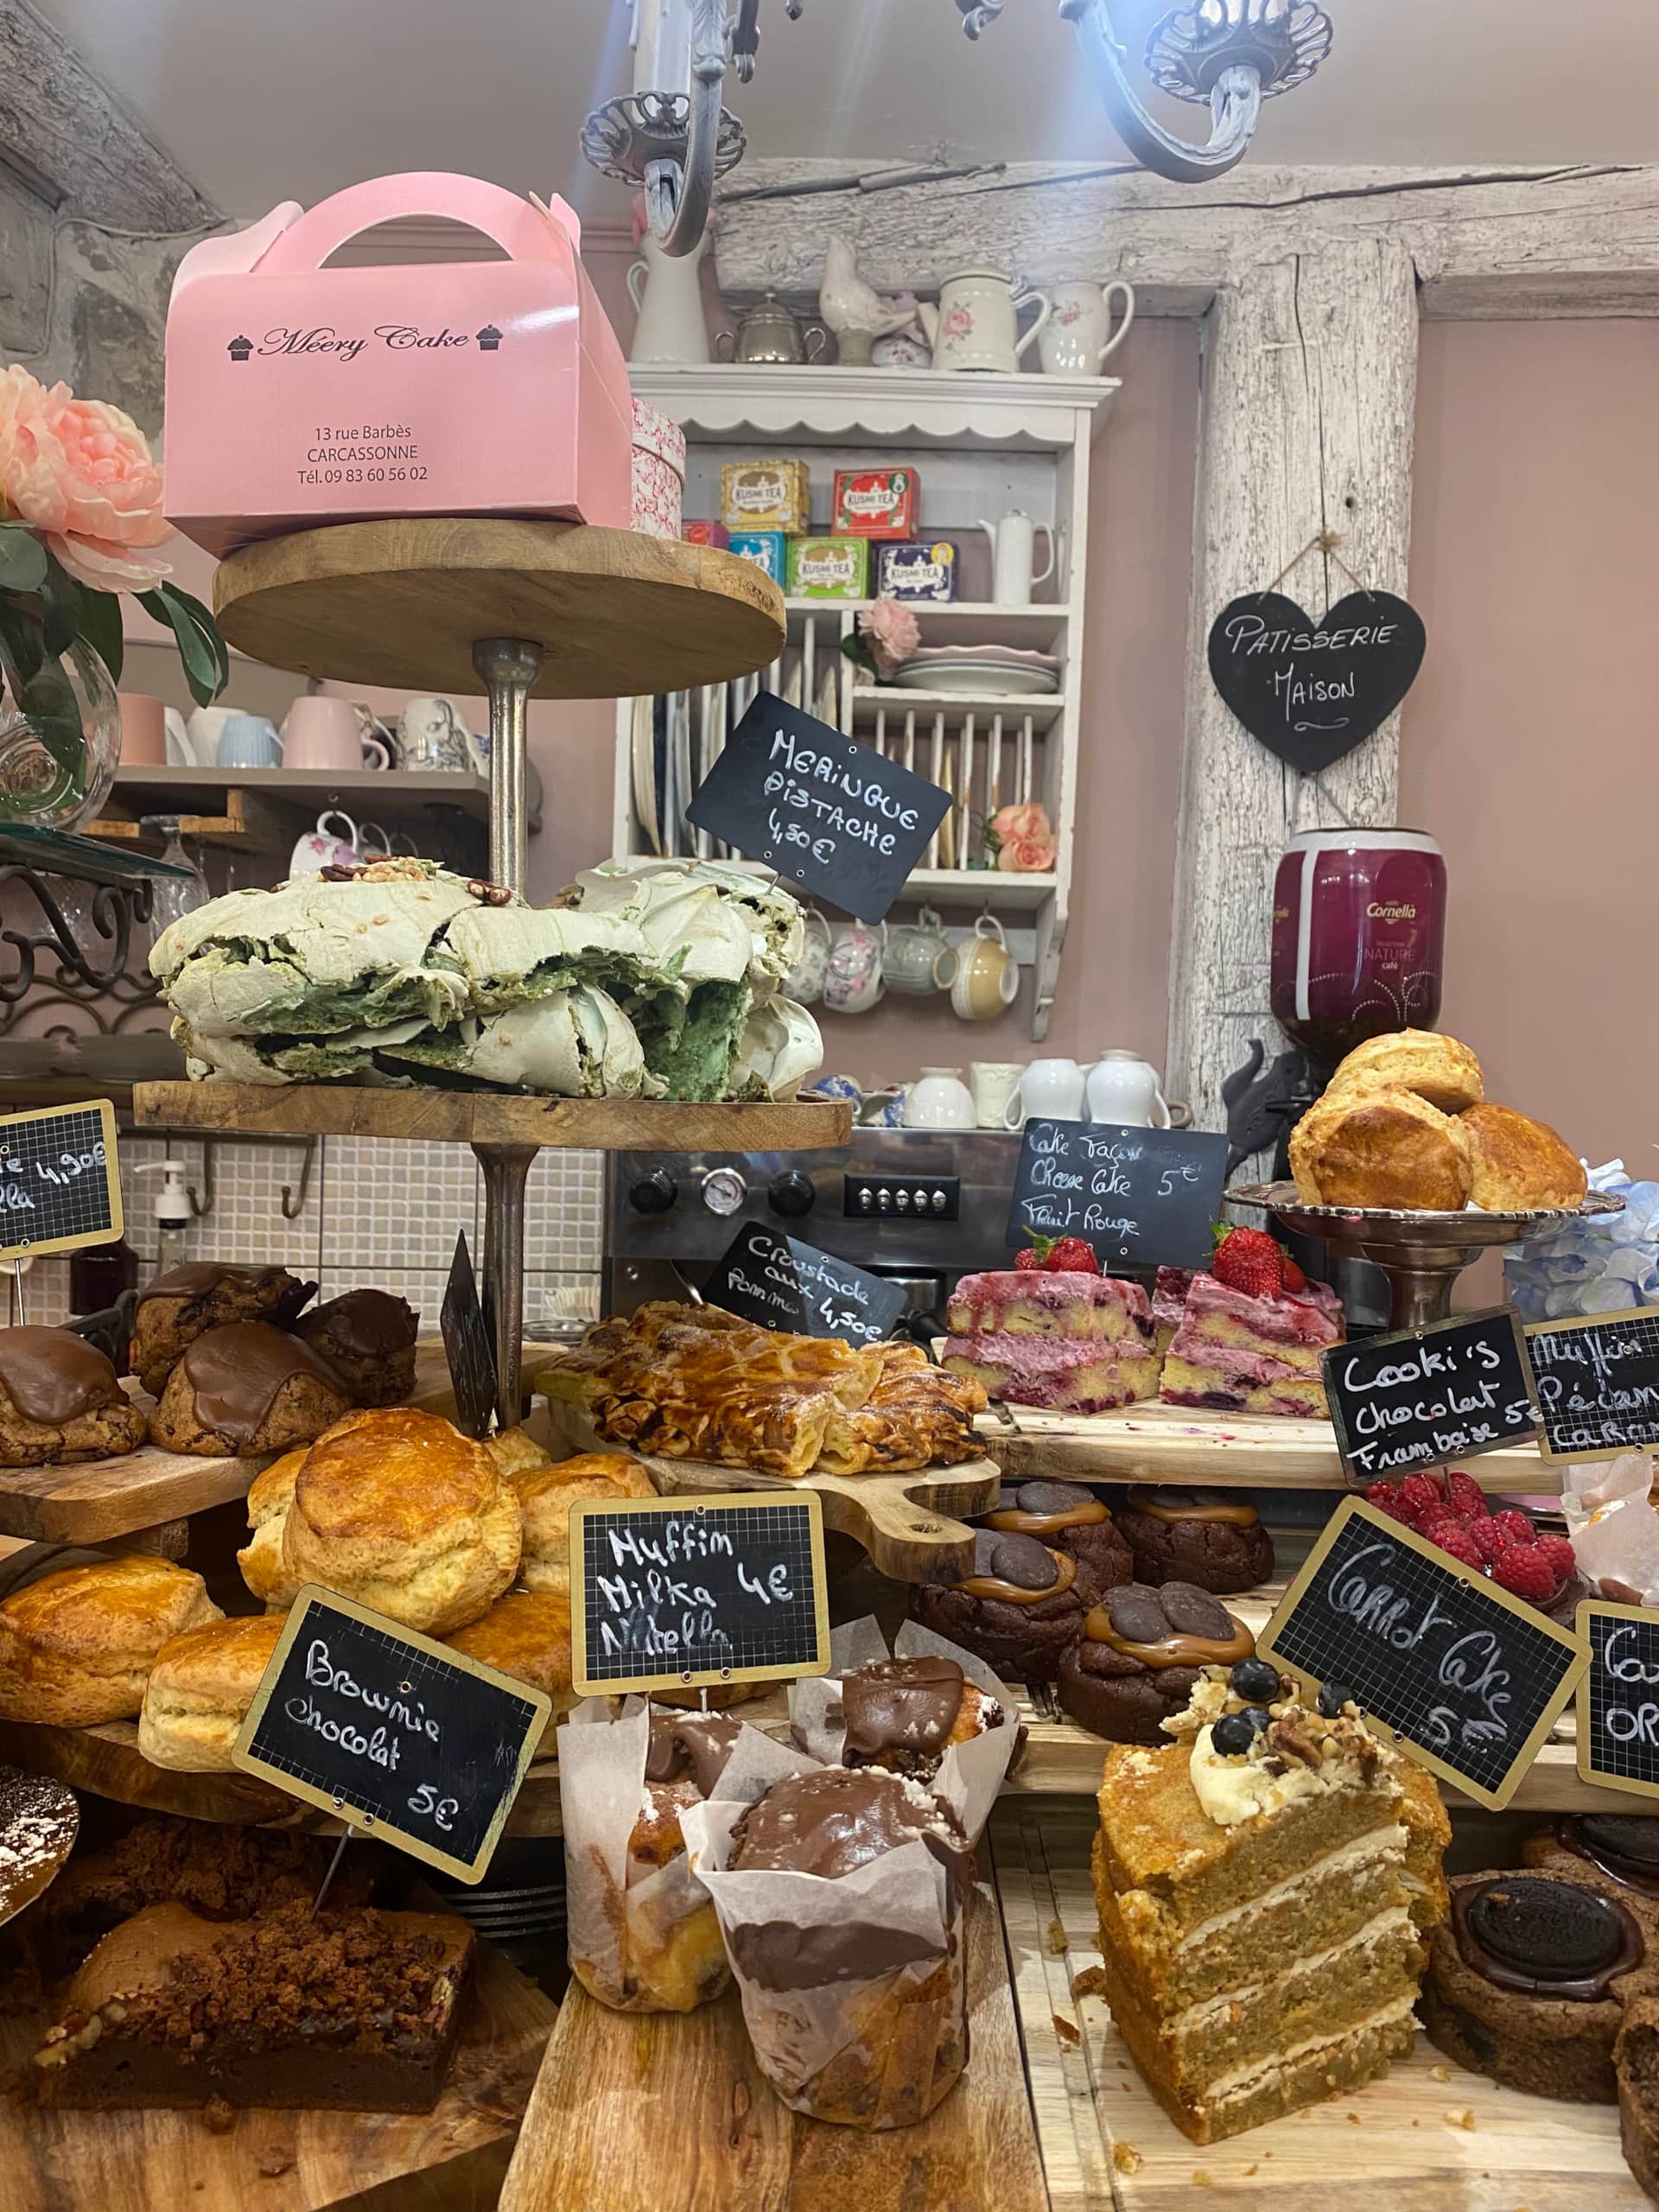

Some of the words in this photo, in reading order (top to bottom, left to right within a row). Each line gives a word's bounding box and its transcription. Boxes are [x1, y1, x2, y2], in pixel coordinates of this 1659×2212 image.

[257, 327, 368, 362] Méery
[374, 325, 469, 349] Cake
[315, 427, 331, 441] 13
[335, 428, 359, 441] rue
[363, 423, 411, 439] Barbès
[307, 445, 418, 462] CARCASSONNE
[324, 469, 342, 483] 09
[346, 468, 363, 482] 83
[367, 467, 385, 481] 60
[389, 467, 406, 480] 56
[410, 467, 428, 480] 02
[766, 486, 782, 499] TEA
[878, 493, 894, 504] TEA
[833, 563, 850, 575] TEA
[922, 567, 939, 578] TEA
[1363, 947, 1415, 962] NATURE
[1029, 1123, 1069, 1155] Cake
[1090, 1168, 1131, 1197] Cake
[1084, 1204, 1141, 1238] Rouge
[747, 1236, 869, 1306] Croustade
[764, 1266, 815, 1300] aux
[1355, 1380, 1501, 1434] Chocolat
[1345, 1421, 1499, 1470] Framboise
[596, 1567, 718, 1613] Milka
[304, 1638, 443, 1743] Brownie
[1438, 1630, 1512, 1728] Cake
[283, 1695, 401, 1771] Chocolat
